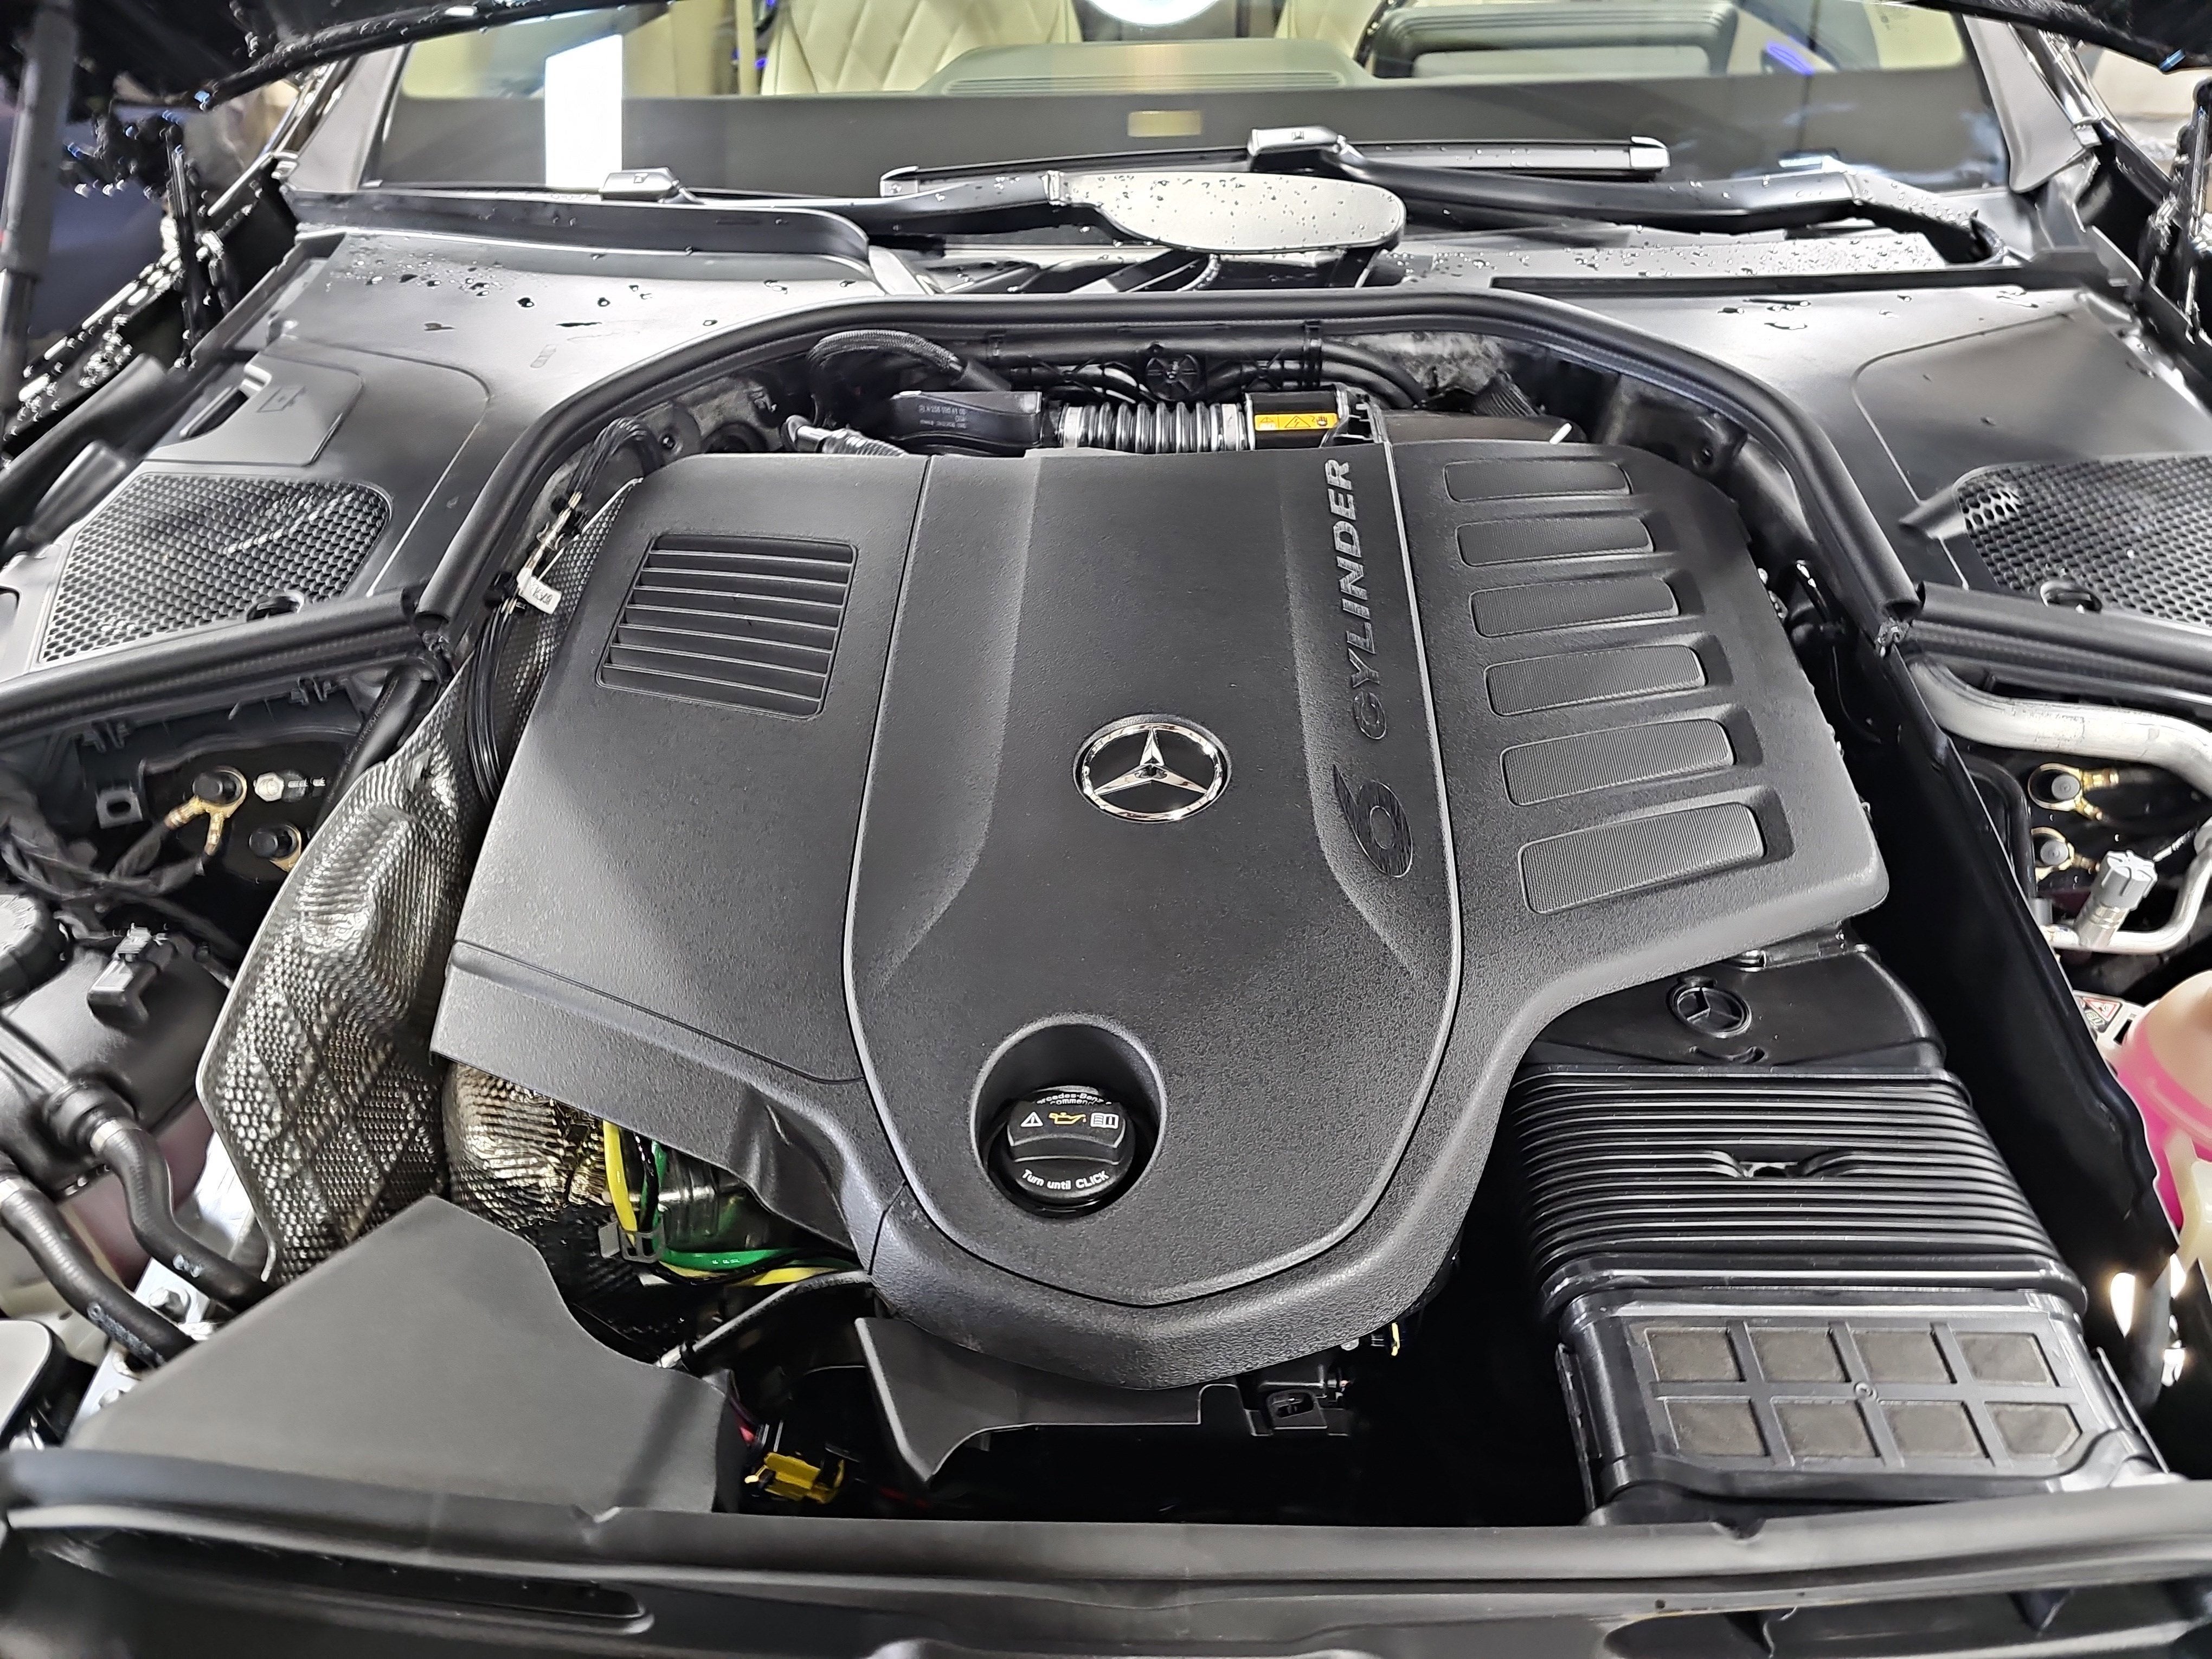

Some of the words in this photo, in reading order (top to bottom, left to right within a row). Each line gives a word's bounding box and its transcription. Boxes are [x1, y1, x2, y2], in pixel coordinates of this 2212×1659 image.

[1324, 458, 1387, 740] CYLINDER
[1332, 763, 1413, 878] 6
[1036, 1092, 1104, 1104] ercedes-Benz
[1022, 1169, 1044, 1186] Turn
[1047, 1180, 1071, 1190] until
[1076, 1170, 1110, 1188] CLICK
